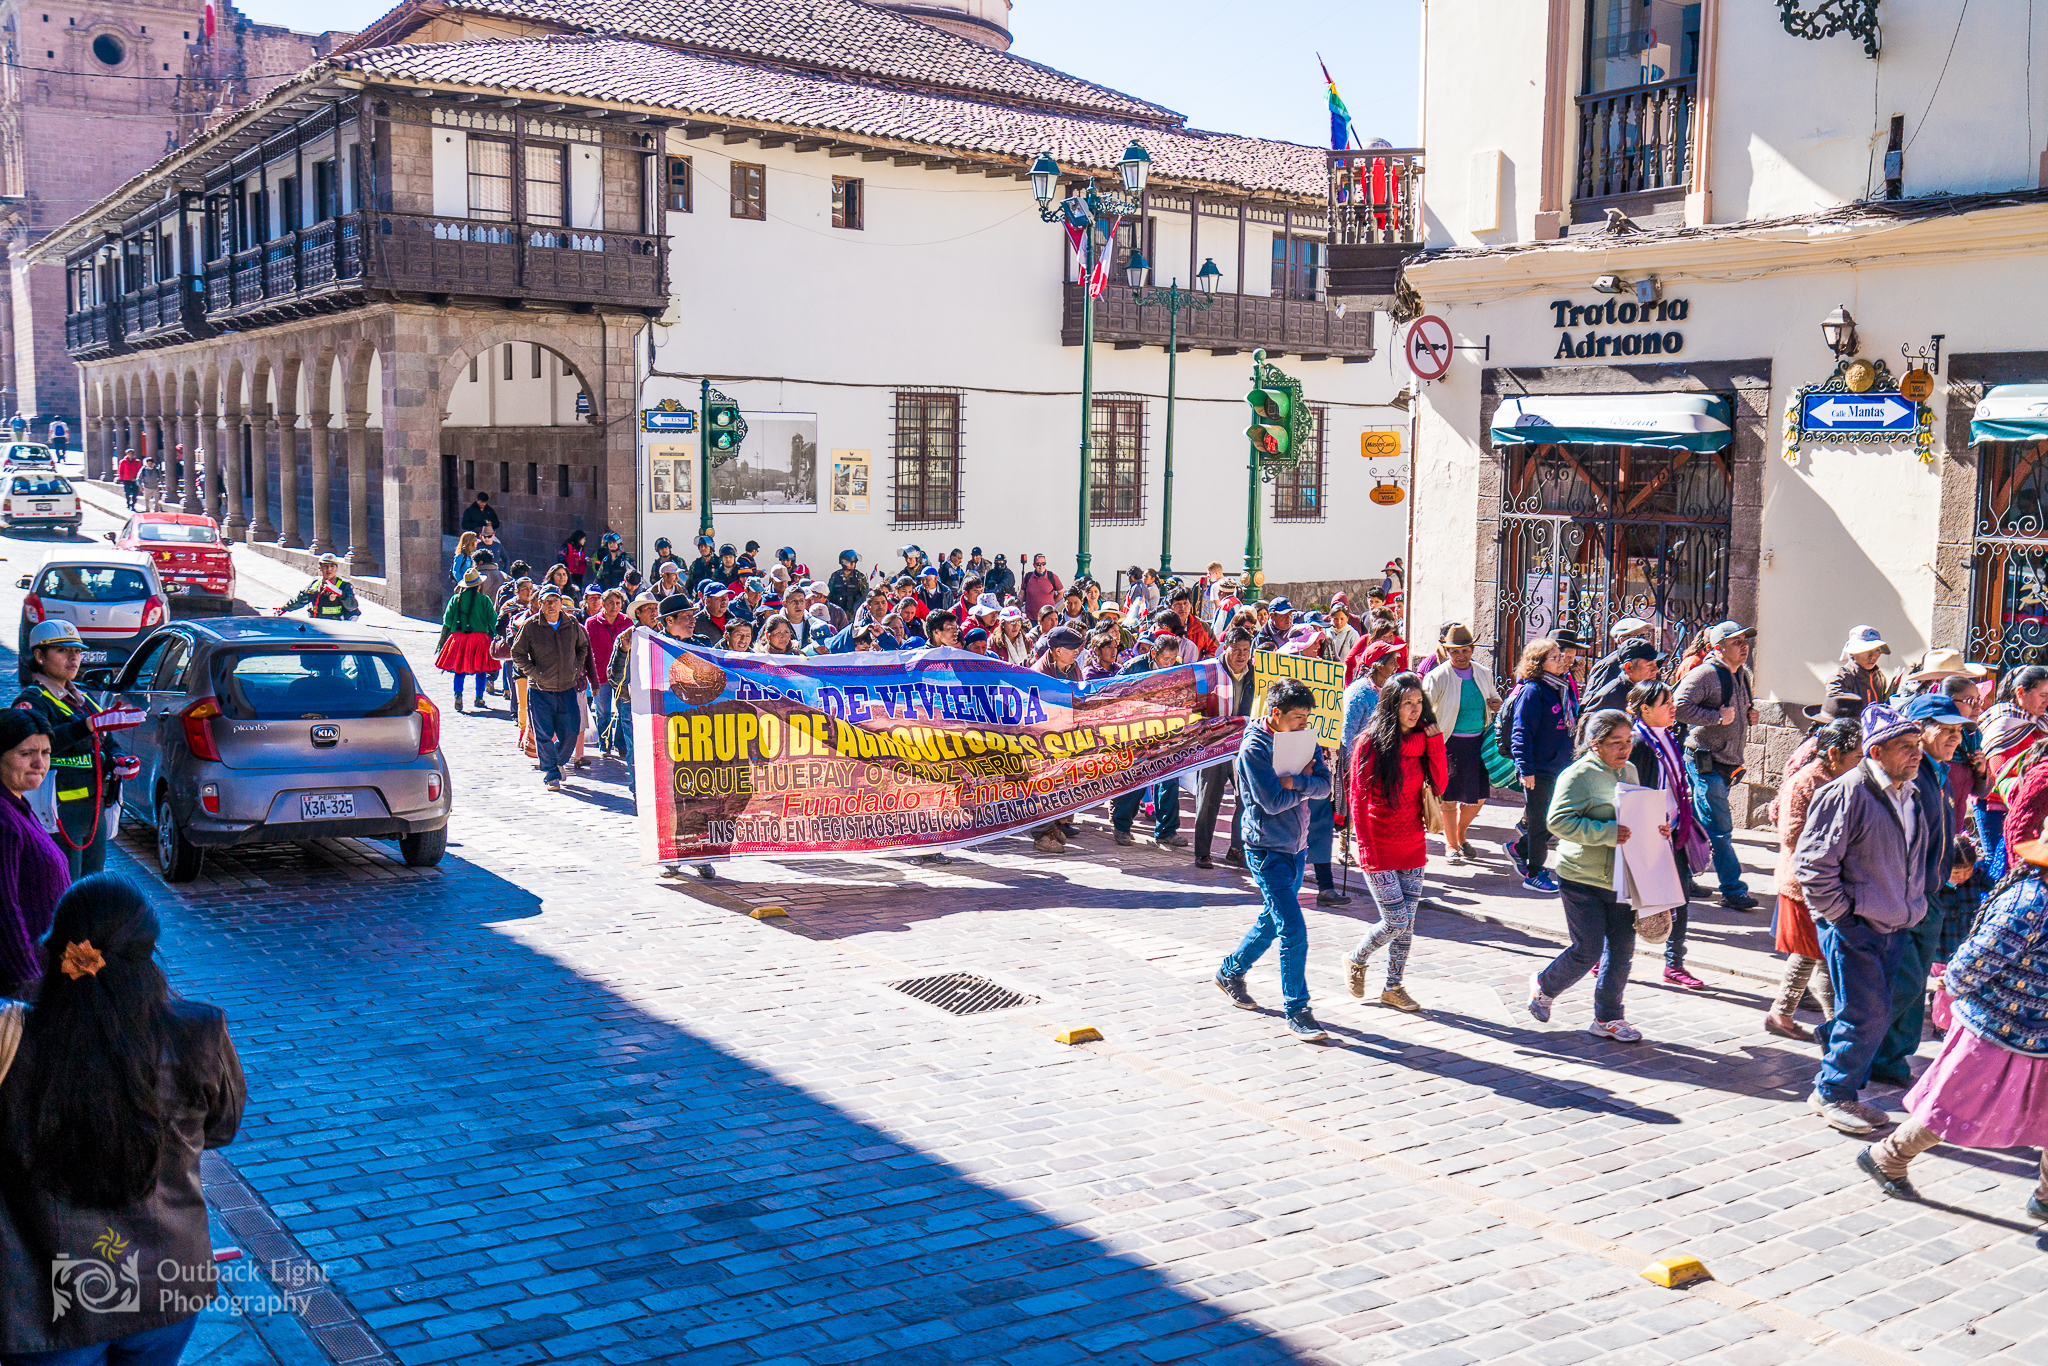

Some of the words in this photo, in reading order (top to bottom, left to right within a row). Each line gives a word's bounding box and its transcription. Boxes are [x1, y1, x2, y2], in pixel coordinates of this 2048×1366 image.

[1550, 297, 1689, 328] Tratoria
[1554, 331, 1683, 359] Adriano
[1831, 410, 1847, 418] Calle
[1848, 405, 1885, 418] Mantas
[1254, 650, 1344, 689] JUSTICIA
[816, 686, 874, 725] DE
[874, 682, 1049, 726] VIVIENDA
[317, 728, 335, 737] KIA
[667, 712, 782, 763] GRUPO
[789, 713, 830, 757] DE
[1043, 728, 1097, 759] SIN
[674, 761, 859, 797] QQUEHUEPAY
[864, 762, 884, 786] O
[892, 761, 962, 786] CRUZ
[959, 751, 1043, 780] VERDE
[781, 787, 922, 819] Fundado
[933, 749, 1135, 808] 11-mayo-1989
[304, 799, 353, 816] X3A-325
[707, 819, 781, 844] INSCRITO
[785, 819, 807, 842] EN
[810, 813, 895, 843] REGISTROS
[898, 808, 972, 836] PUBLICOS
[974, 796, 1038, 829] ASIENTO
[1041, 774, 1121, 813] REGISTRAL
